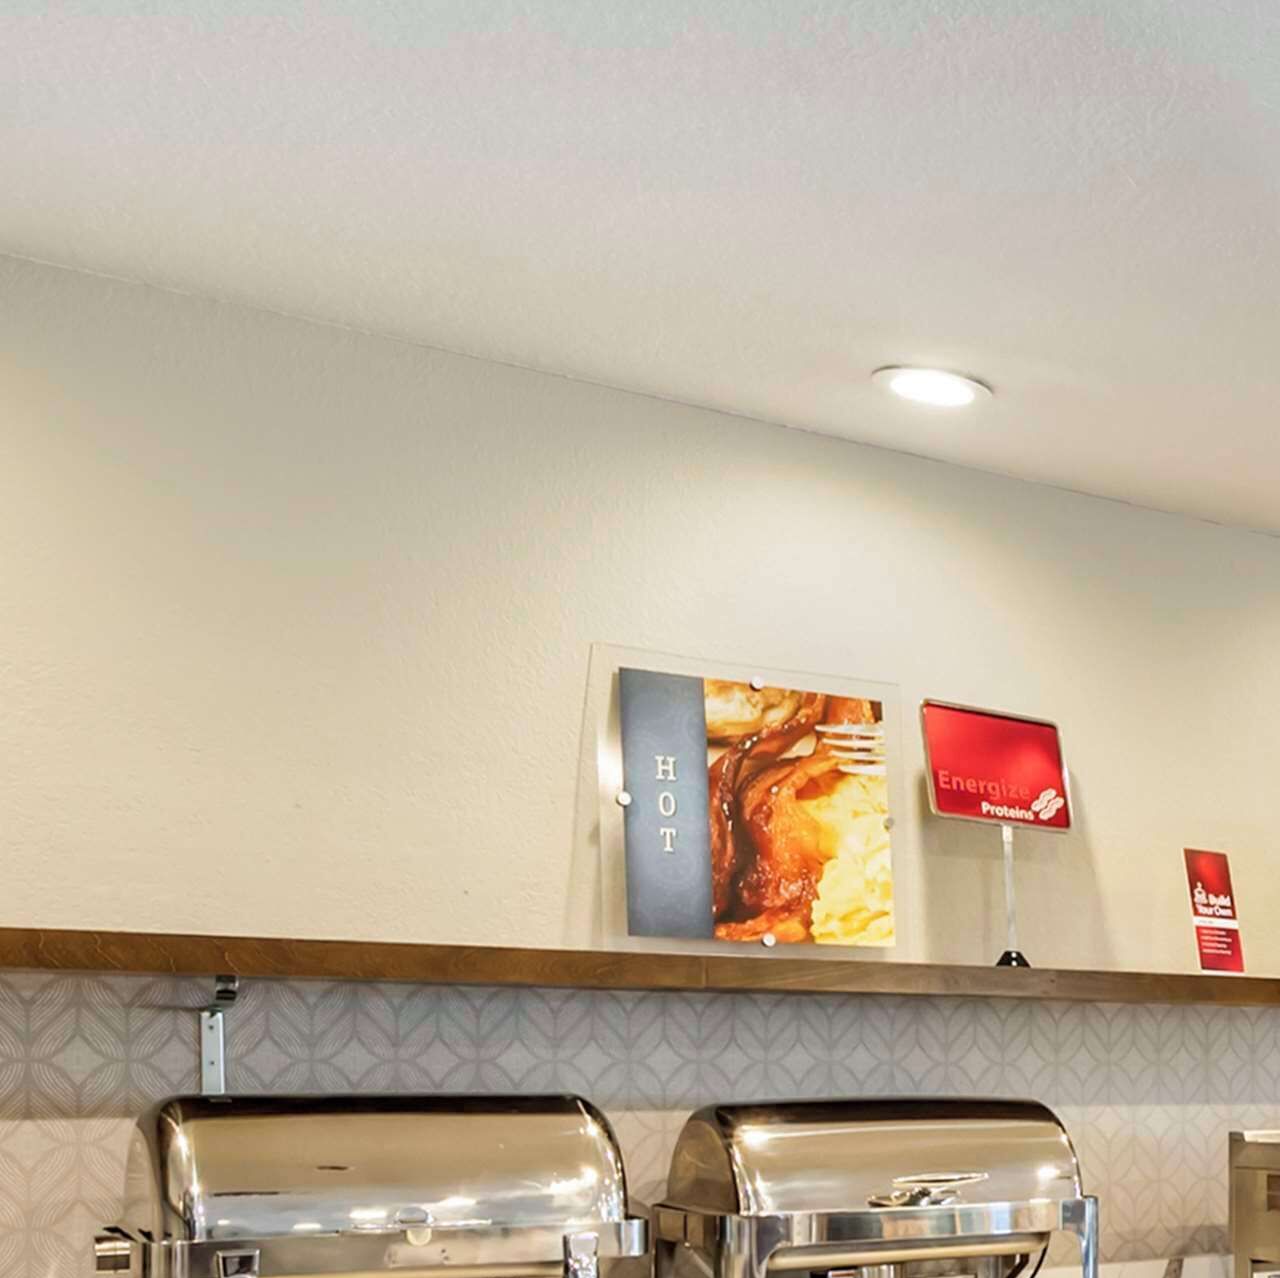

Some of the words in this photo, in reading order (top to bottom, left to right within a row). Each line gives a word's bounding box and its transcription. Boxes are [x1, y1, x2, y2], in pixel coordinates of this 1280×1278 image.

[938, 770, 1031, 800] Energize
[655, 755, 677, 852] HOT
[981, 801, 1035, 820] Proteins
